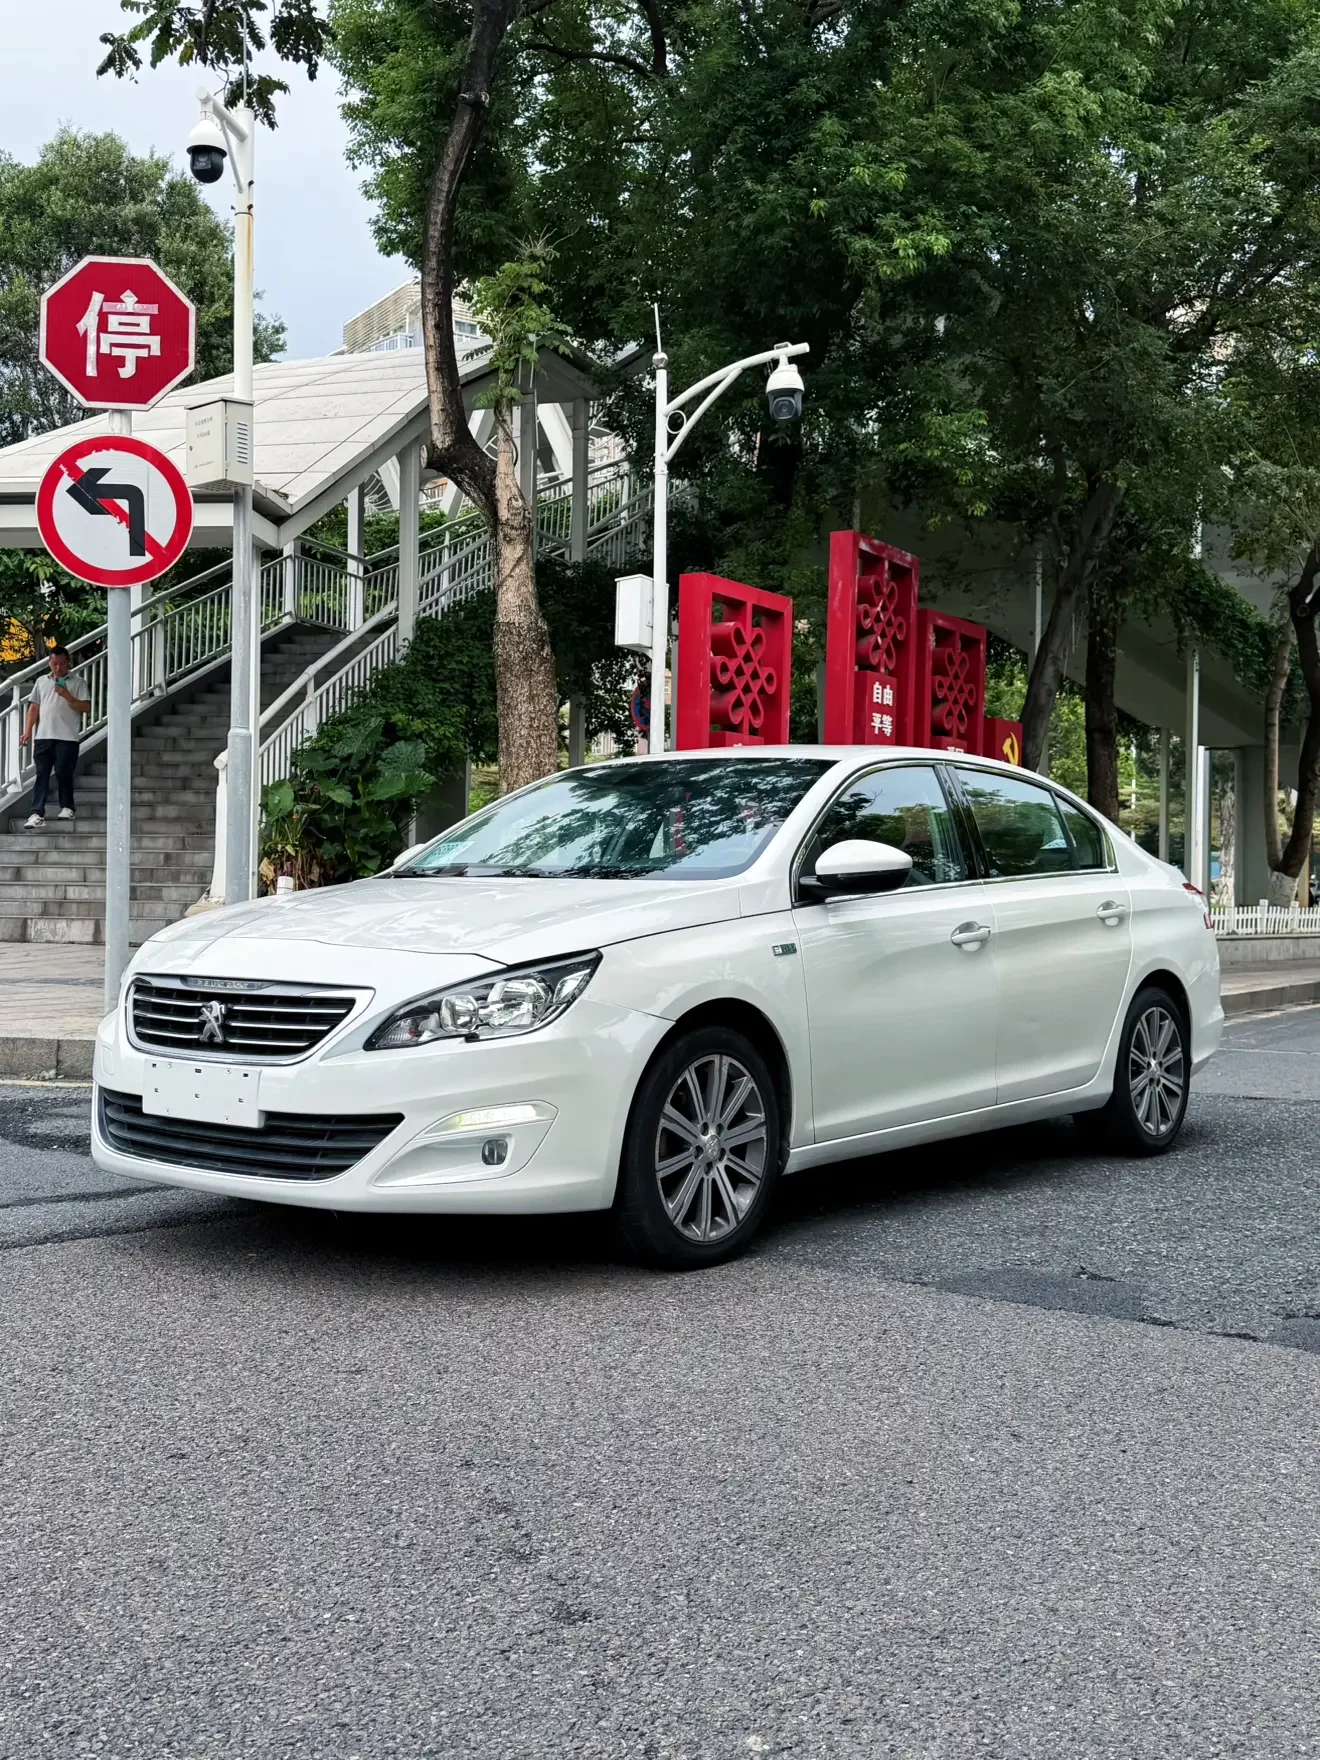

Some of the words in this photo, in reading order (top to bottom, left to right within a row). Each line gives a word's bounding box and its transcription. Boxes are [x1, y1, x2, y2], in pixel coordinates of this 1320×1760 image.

[76, 289, 162, 379] 停
[873, 681, 893, 707] 自由
[871, 712, 893, 737] 平等
